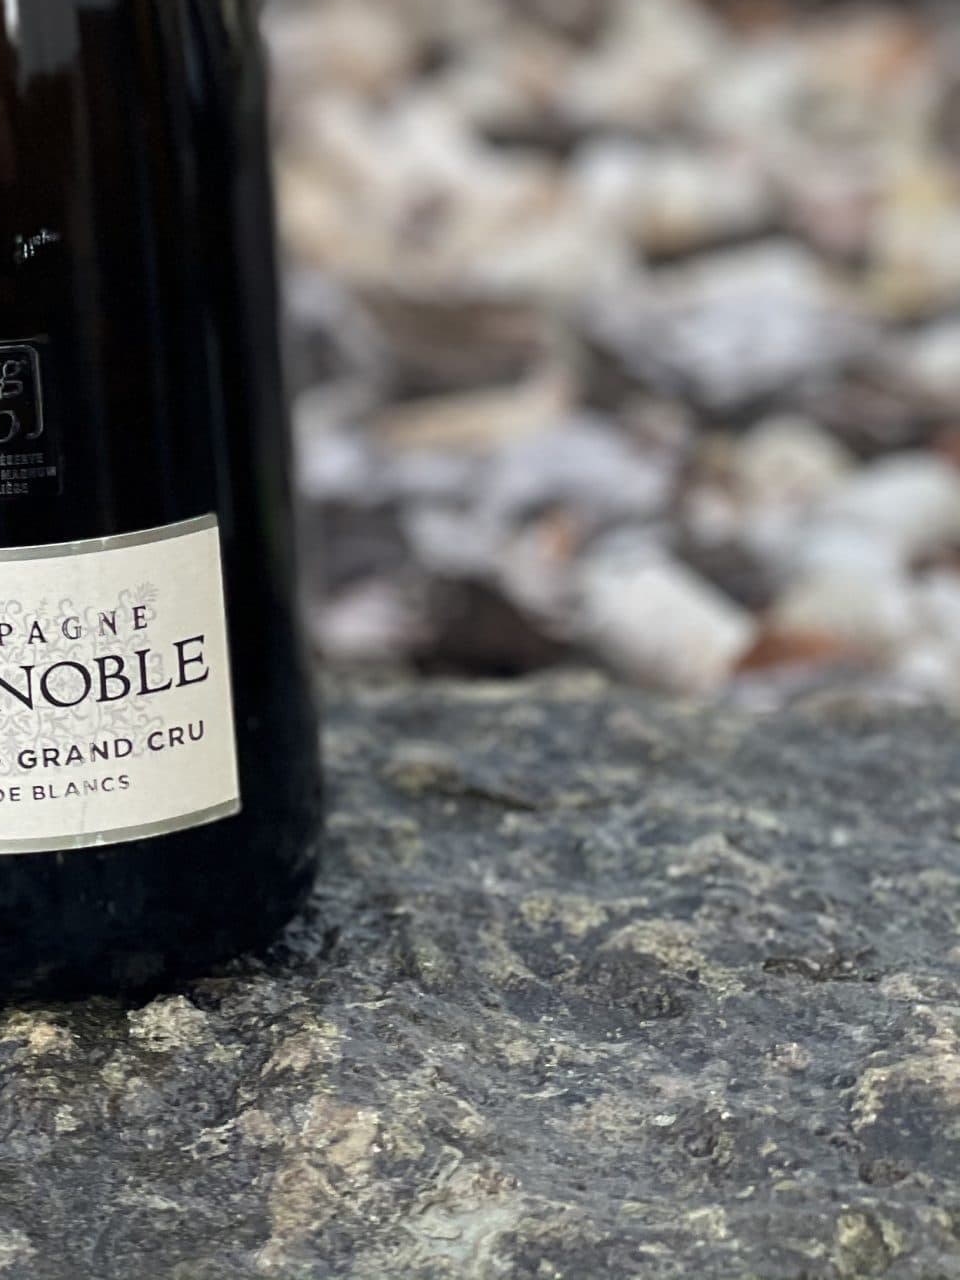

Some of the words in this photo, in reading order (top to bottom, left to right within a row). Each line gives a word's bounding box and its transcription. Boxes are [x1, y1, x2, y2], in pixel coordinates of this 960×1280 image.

[17, 737, 133, 771] GRAND
[147, 719, 205, 752] CRU
[32, 774, 131, 802] BLANCS
